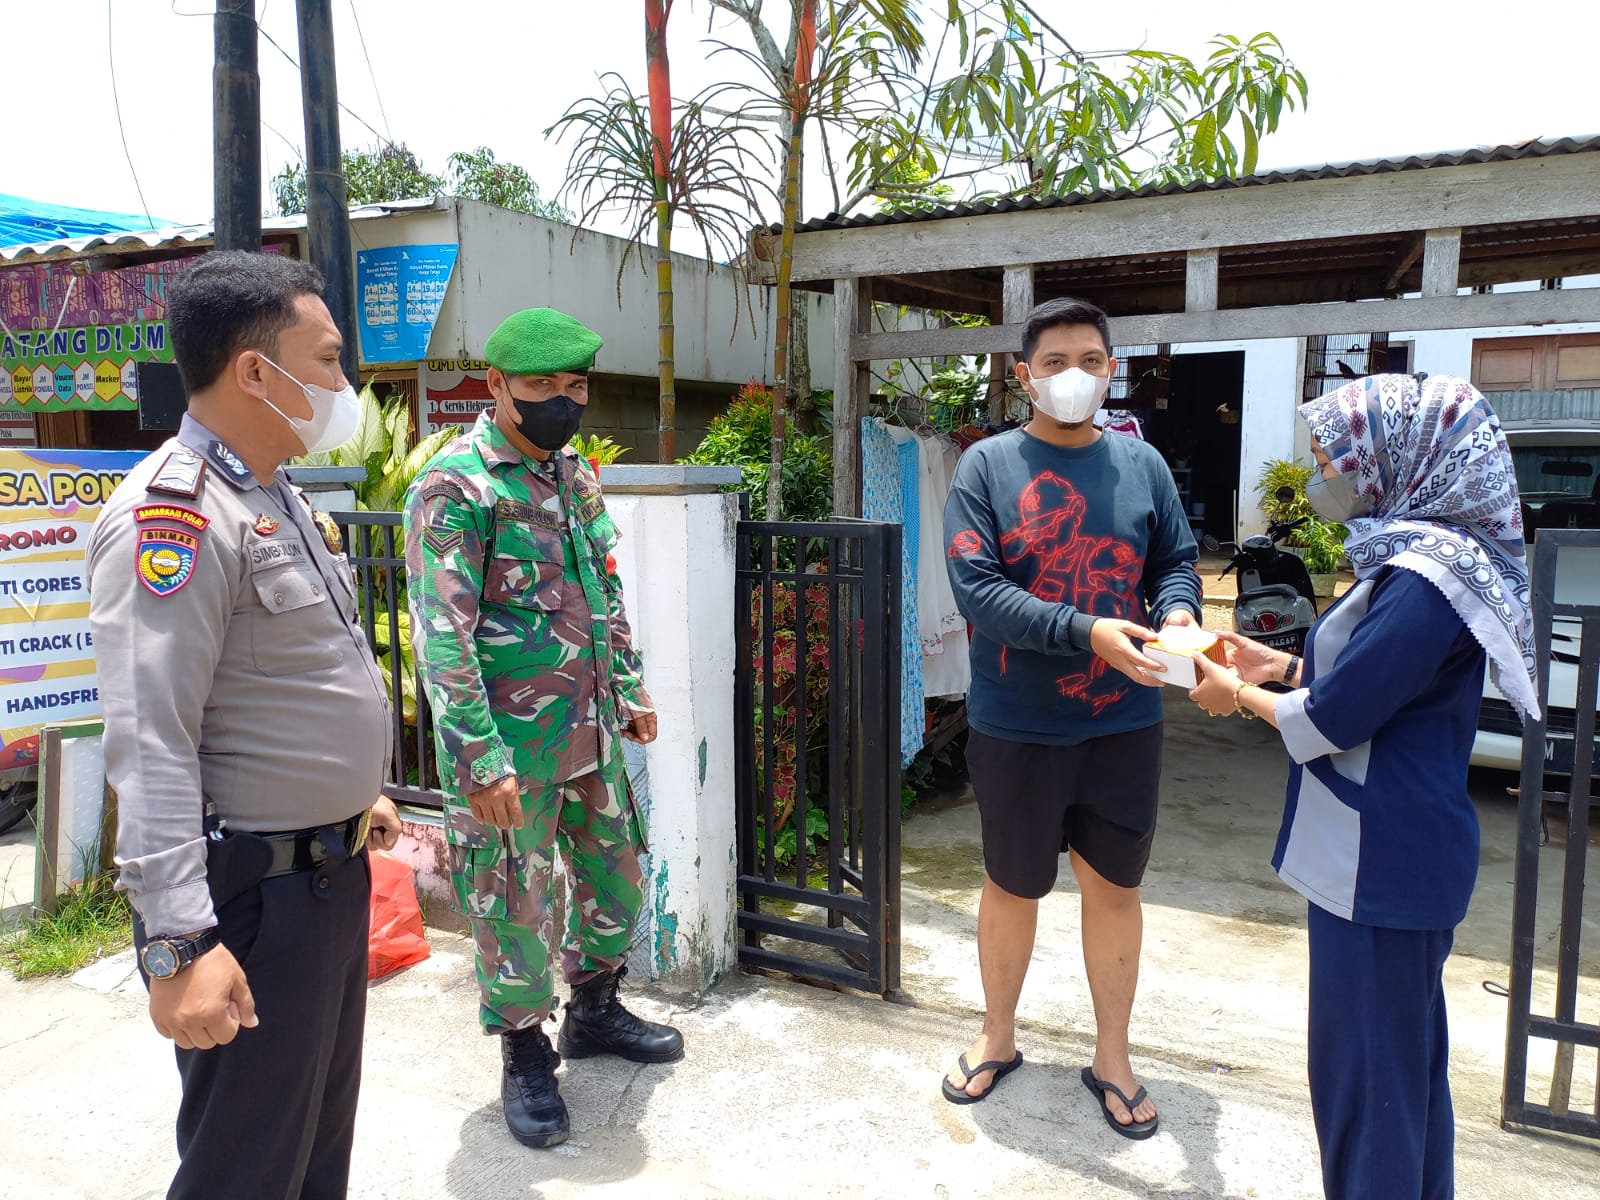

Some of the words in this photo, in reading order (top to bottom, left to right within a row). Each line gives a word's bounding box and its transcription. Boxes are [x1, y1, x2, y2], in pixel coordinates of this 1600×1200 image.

[2, 330, 87, 358] ATANG
[96, 328, 122, 351] DI
[130, 325, 164, 350] JM
[14, 375, 31, 384] Bayar
[77, 383, 94, 391] PONSEL
[146, 531, 193, 545] BINMAS
[0, 580, 18, 595] TI
[22, 576, 82, 594] GORES
[0, 639, 15, 655] TI
[19, 633, 72, 653] CRACK
